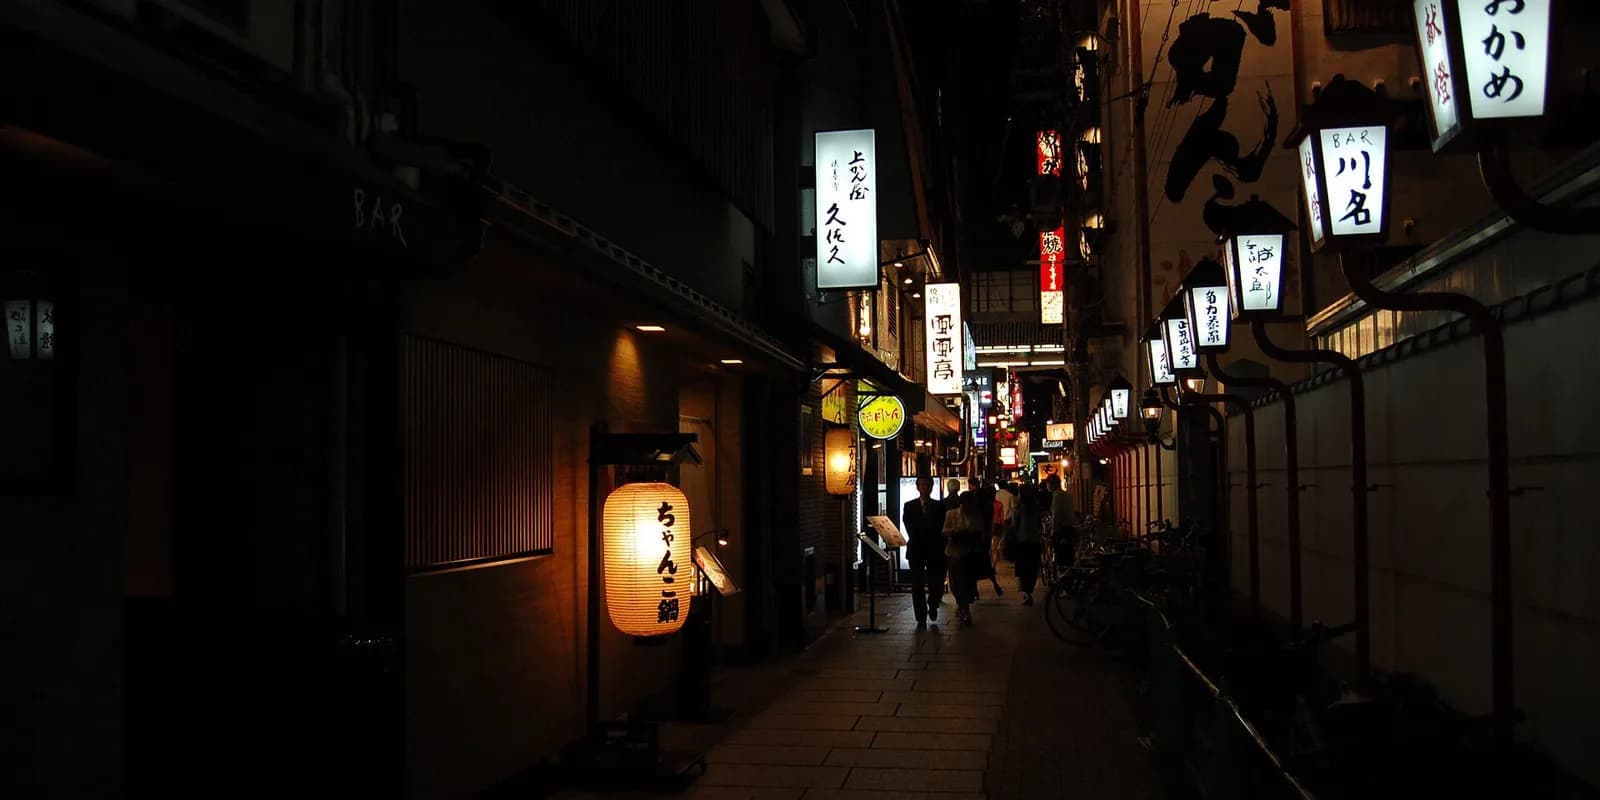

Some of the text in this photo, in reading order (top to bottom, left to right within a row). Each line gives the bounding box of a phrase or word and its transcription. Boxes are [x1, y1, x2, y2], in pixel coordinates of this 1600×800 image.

[1333, 130, 1375, 149] BAR
[848, 150, 869, 201] 上かん屋
[1336, 150, 1372, 226] 川名
[353, 187, 409, 249] BAR
[825, 202, 847, 265] 久佐久
[657, 501, 680, 624] ちゃんこ鍋
